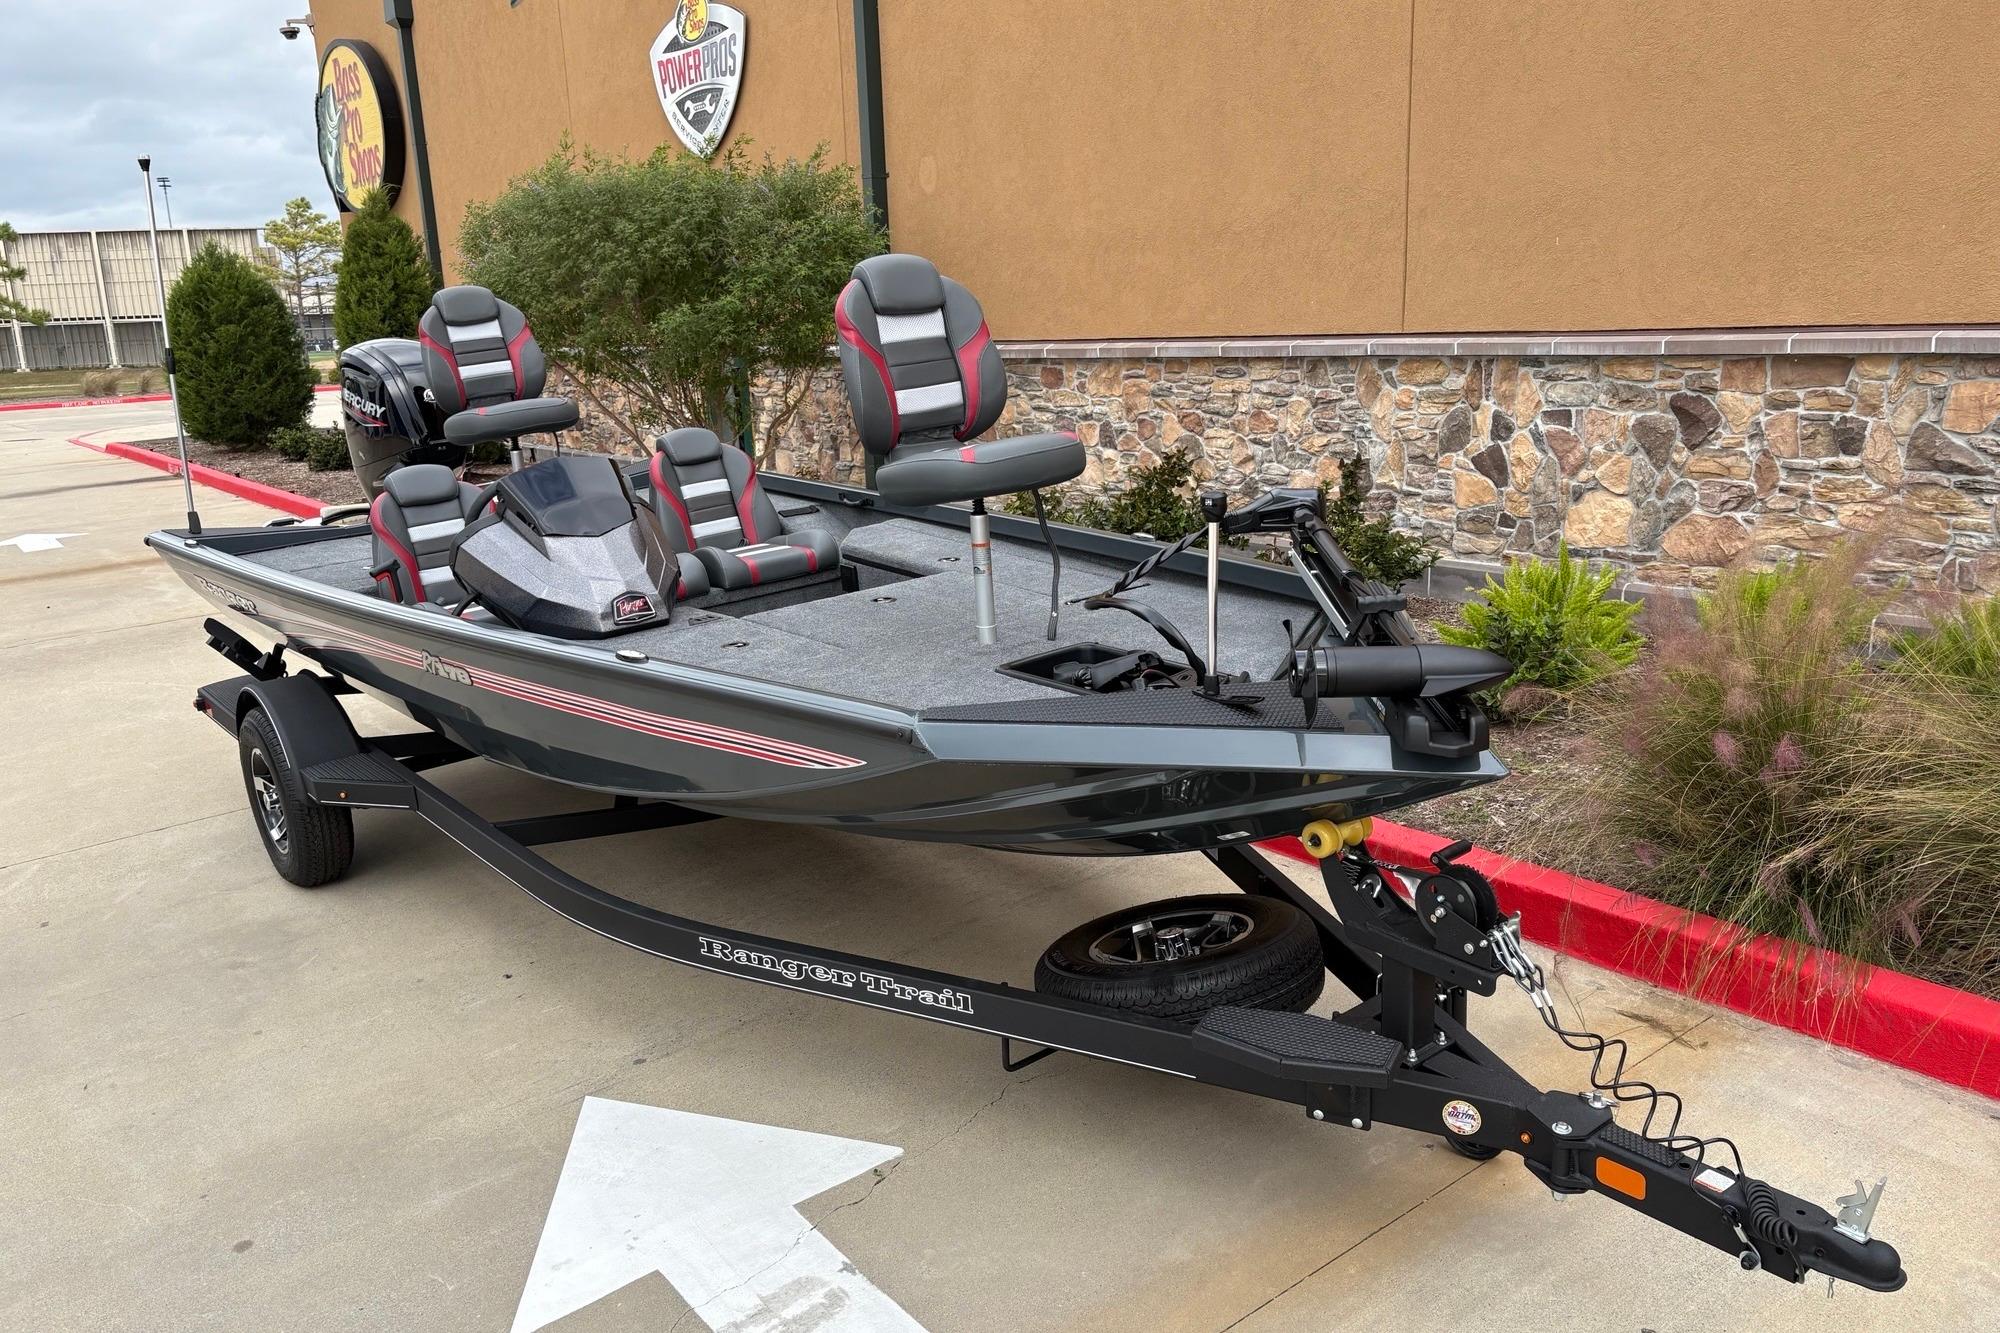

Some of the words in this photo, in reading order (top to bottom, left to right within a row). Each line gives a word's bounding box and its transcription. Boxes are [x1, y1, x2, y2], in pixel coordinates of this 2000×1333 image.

[332, 57, 362, 102] Bass
[341, 102, 363, 146] Pro
[349, 142, 382, 189] Shops
[699, 936, 856, 988] Ranger
[861, 971, 974, 1014] Trail
